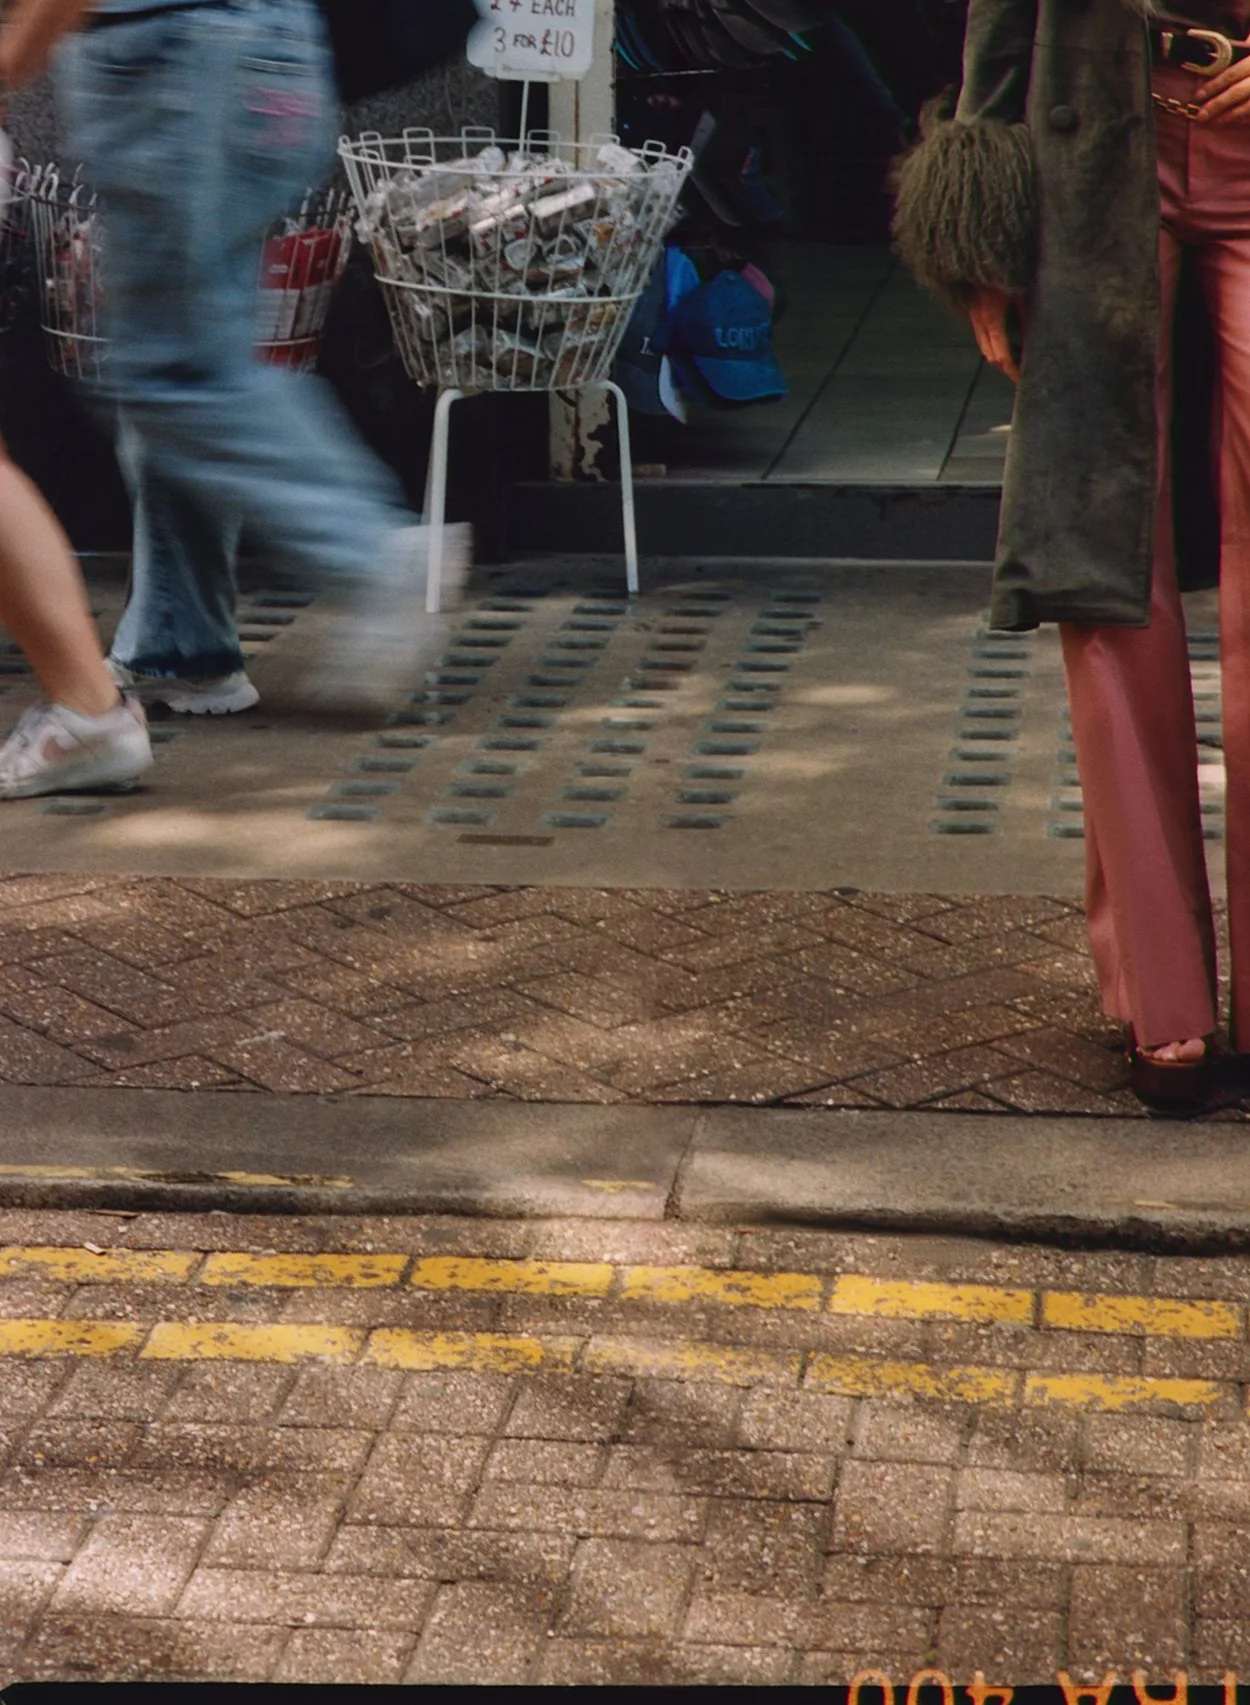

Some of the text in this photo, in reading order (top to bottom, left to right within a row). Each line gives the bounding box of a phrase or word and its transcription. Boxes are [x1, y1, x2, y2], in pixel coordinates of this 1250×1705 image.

[493, 27, 575, 58] 3 FOR £10
